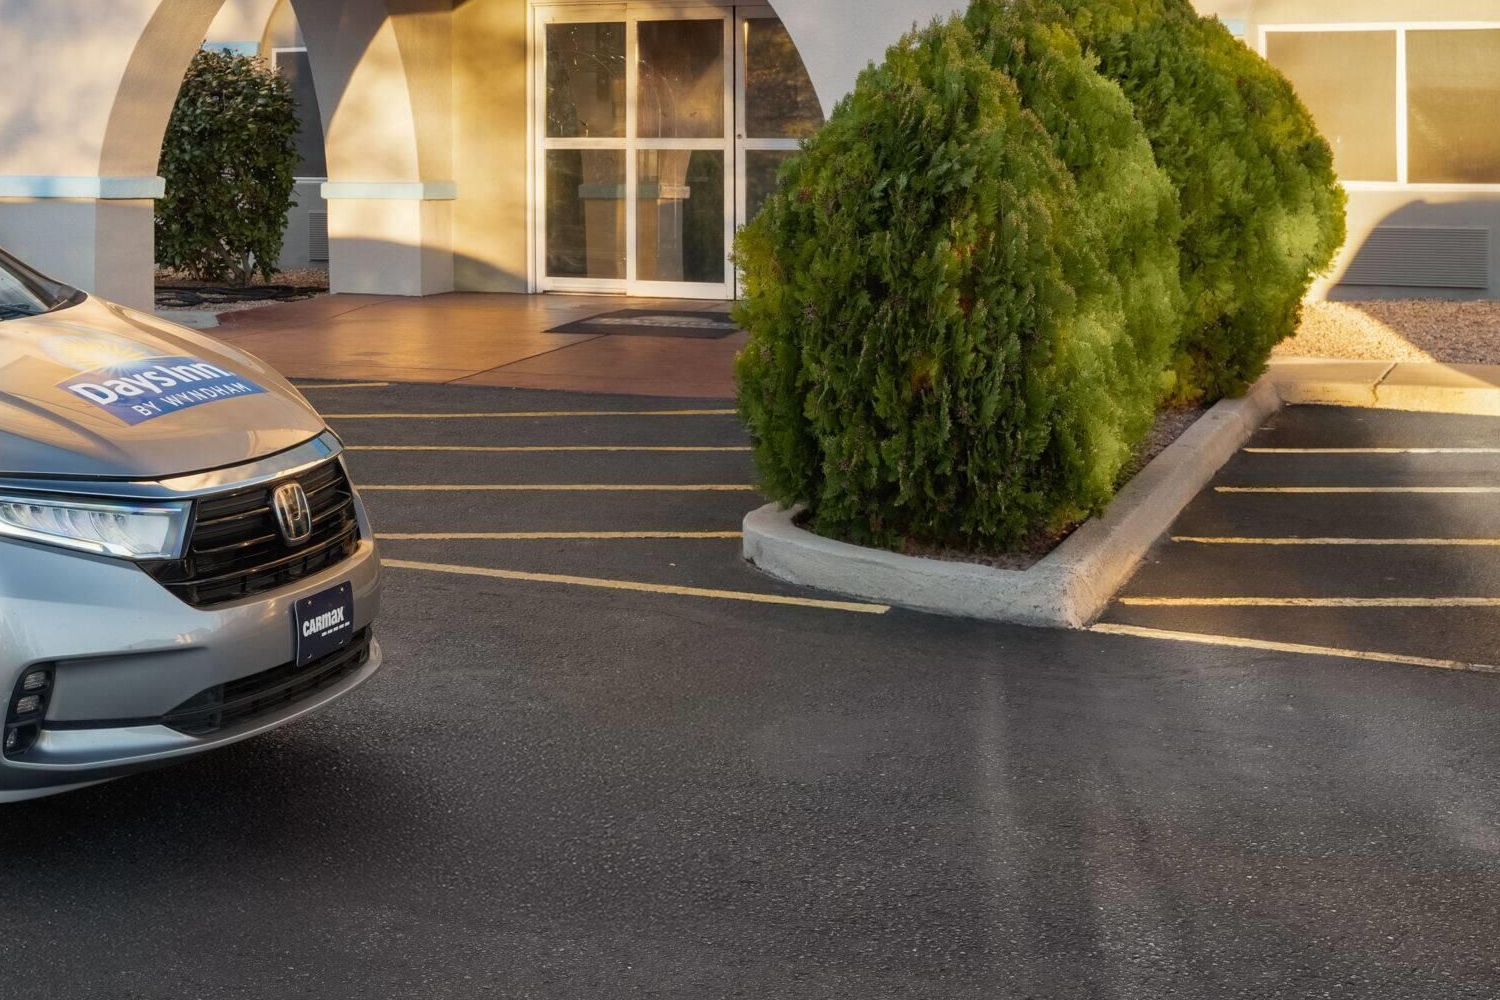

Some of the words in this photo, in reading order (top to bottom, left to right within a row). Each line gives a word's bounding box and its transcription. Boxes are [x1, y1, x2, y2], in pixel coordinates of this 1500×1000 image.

[68, 370, 177, 405] Days
[156, 361, 228, 383] Inn
[132, 400, 162, 416] BY
[160, 382, 252, 407] WYNDHAM
